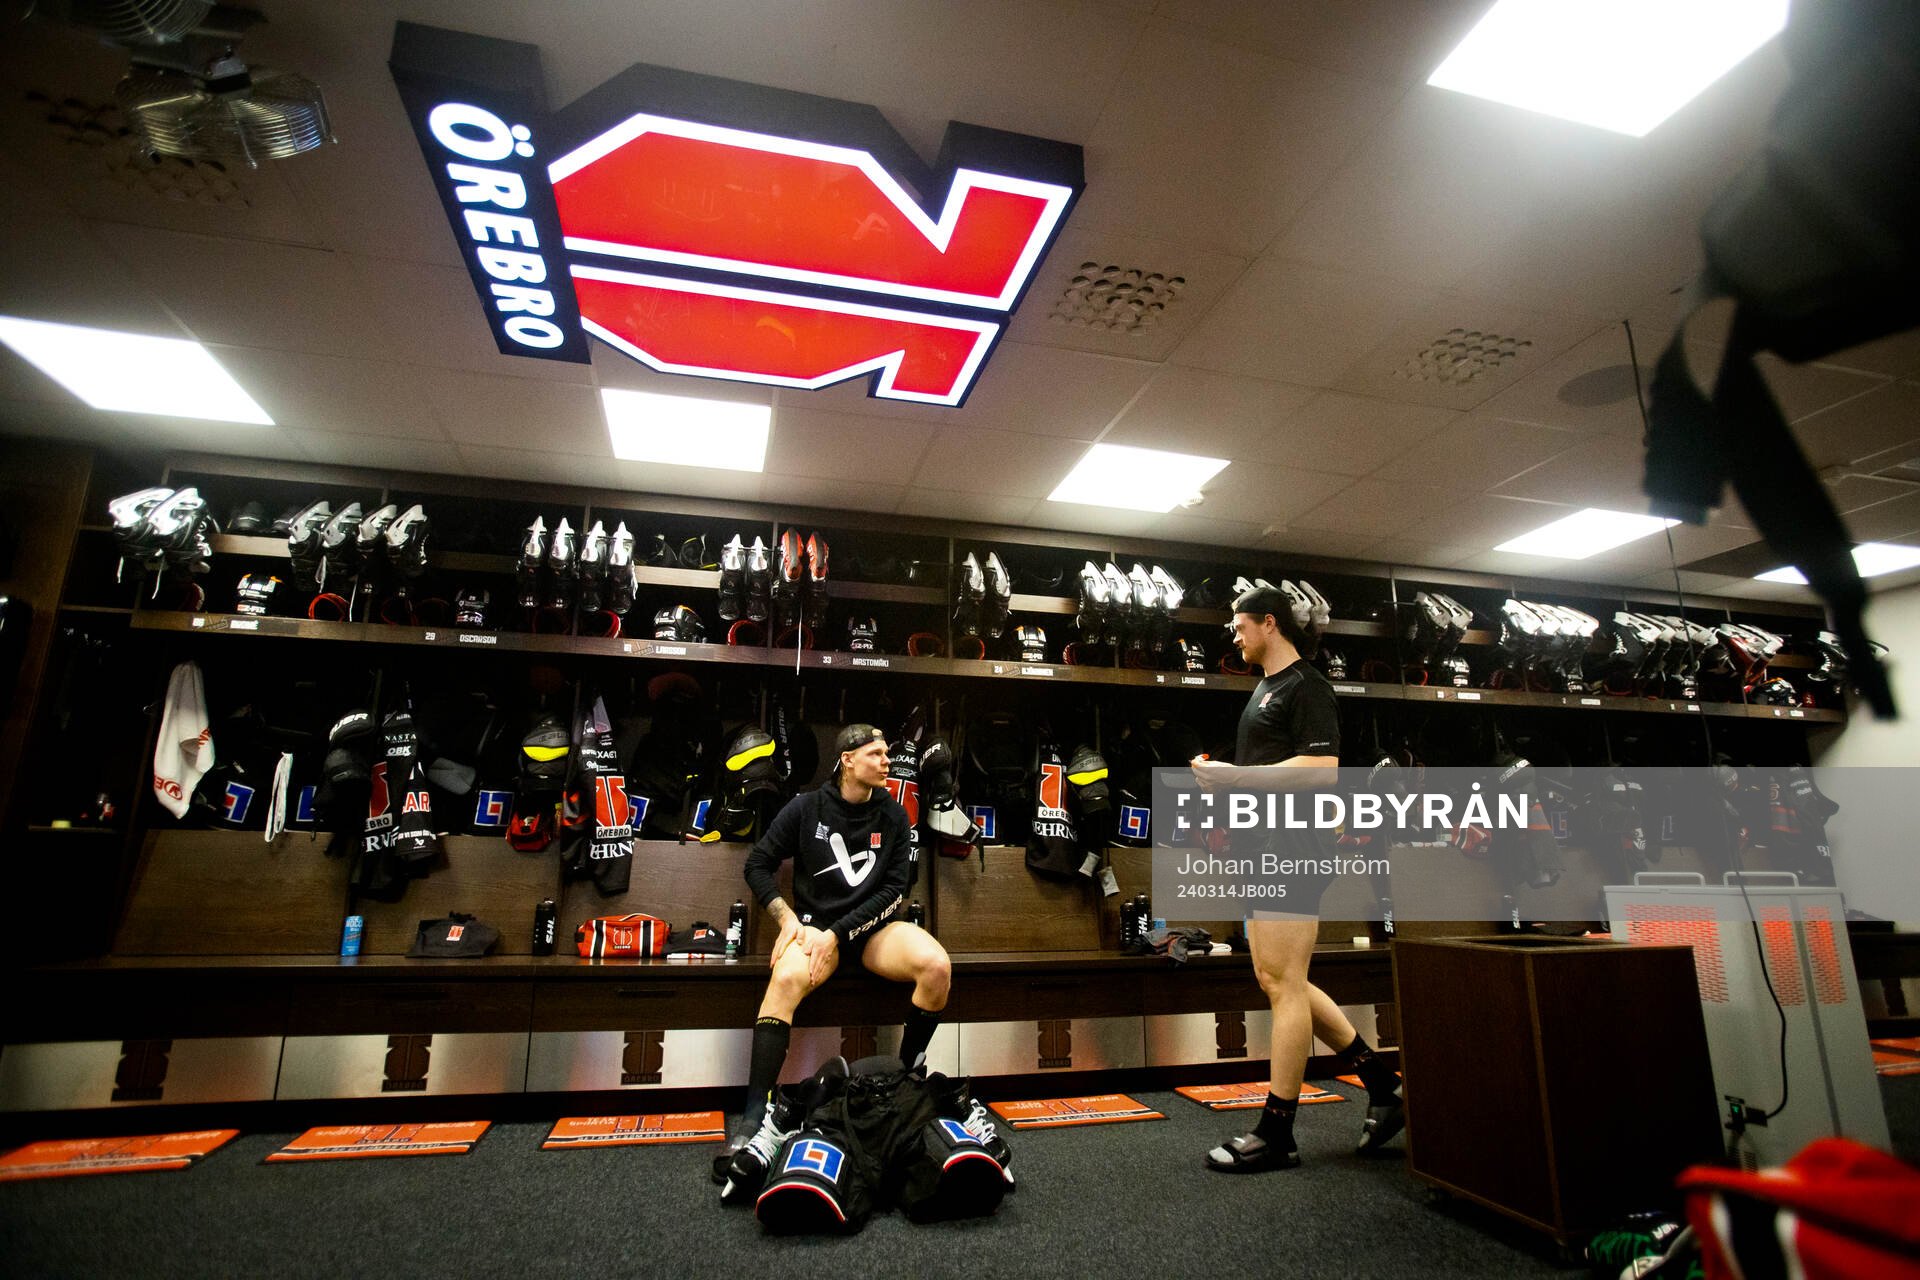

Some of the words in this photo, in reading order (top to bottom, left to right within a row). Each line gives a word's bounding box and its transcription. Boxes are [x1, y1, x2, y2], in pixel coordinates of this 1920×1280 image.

[429, 102, 564, 349] ÖREBRO
[822, 656, 832, 664] 33
[597, 827, 630, 838] ÖREBRO
[545, 916, 556, 945] SHL
